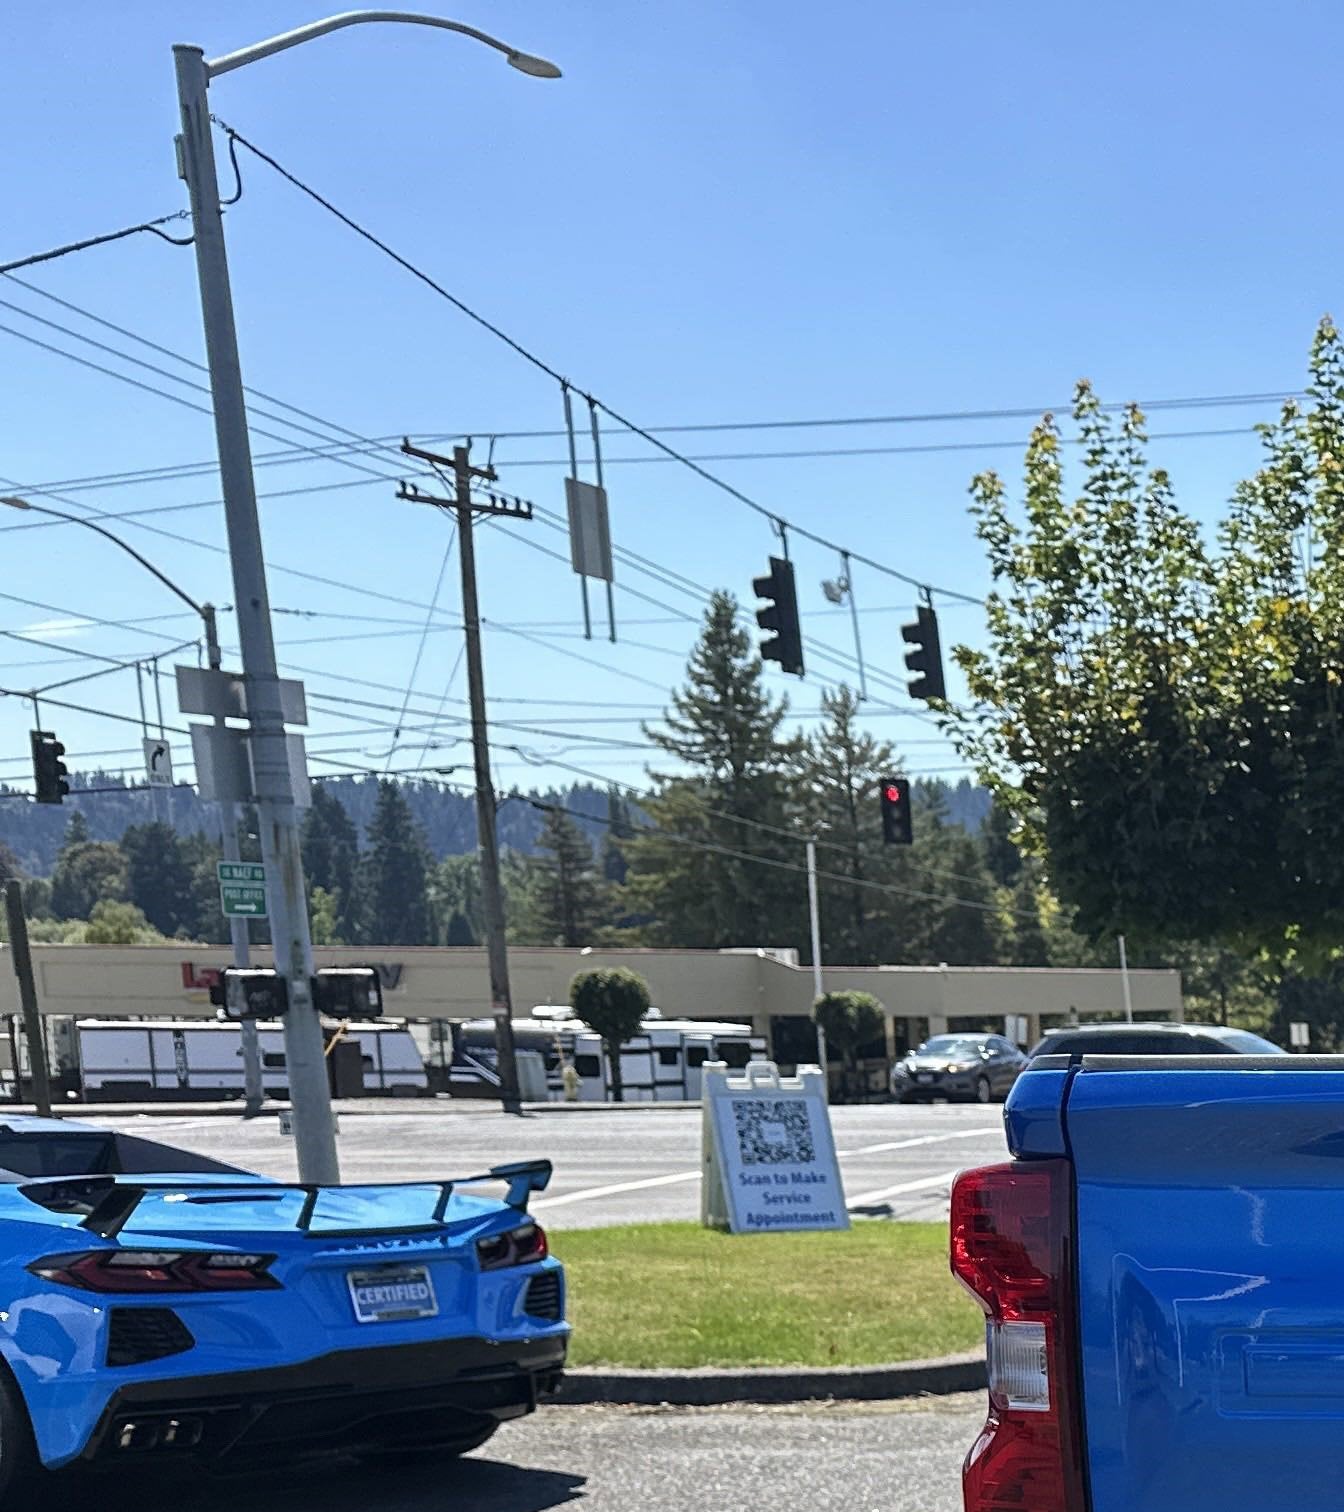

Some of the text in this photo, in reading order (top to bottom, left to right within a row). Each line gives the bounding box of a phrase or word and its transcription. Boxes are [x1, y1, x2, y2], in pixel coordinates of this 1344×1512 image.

[739, 1171, 827, 1186] Scan to Make
[762, 1191, 811, 1205] Service
[746, 1210, 836, 1227] Appointment
[356, 1283, 429, 1305] CERTIFIED
